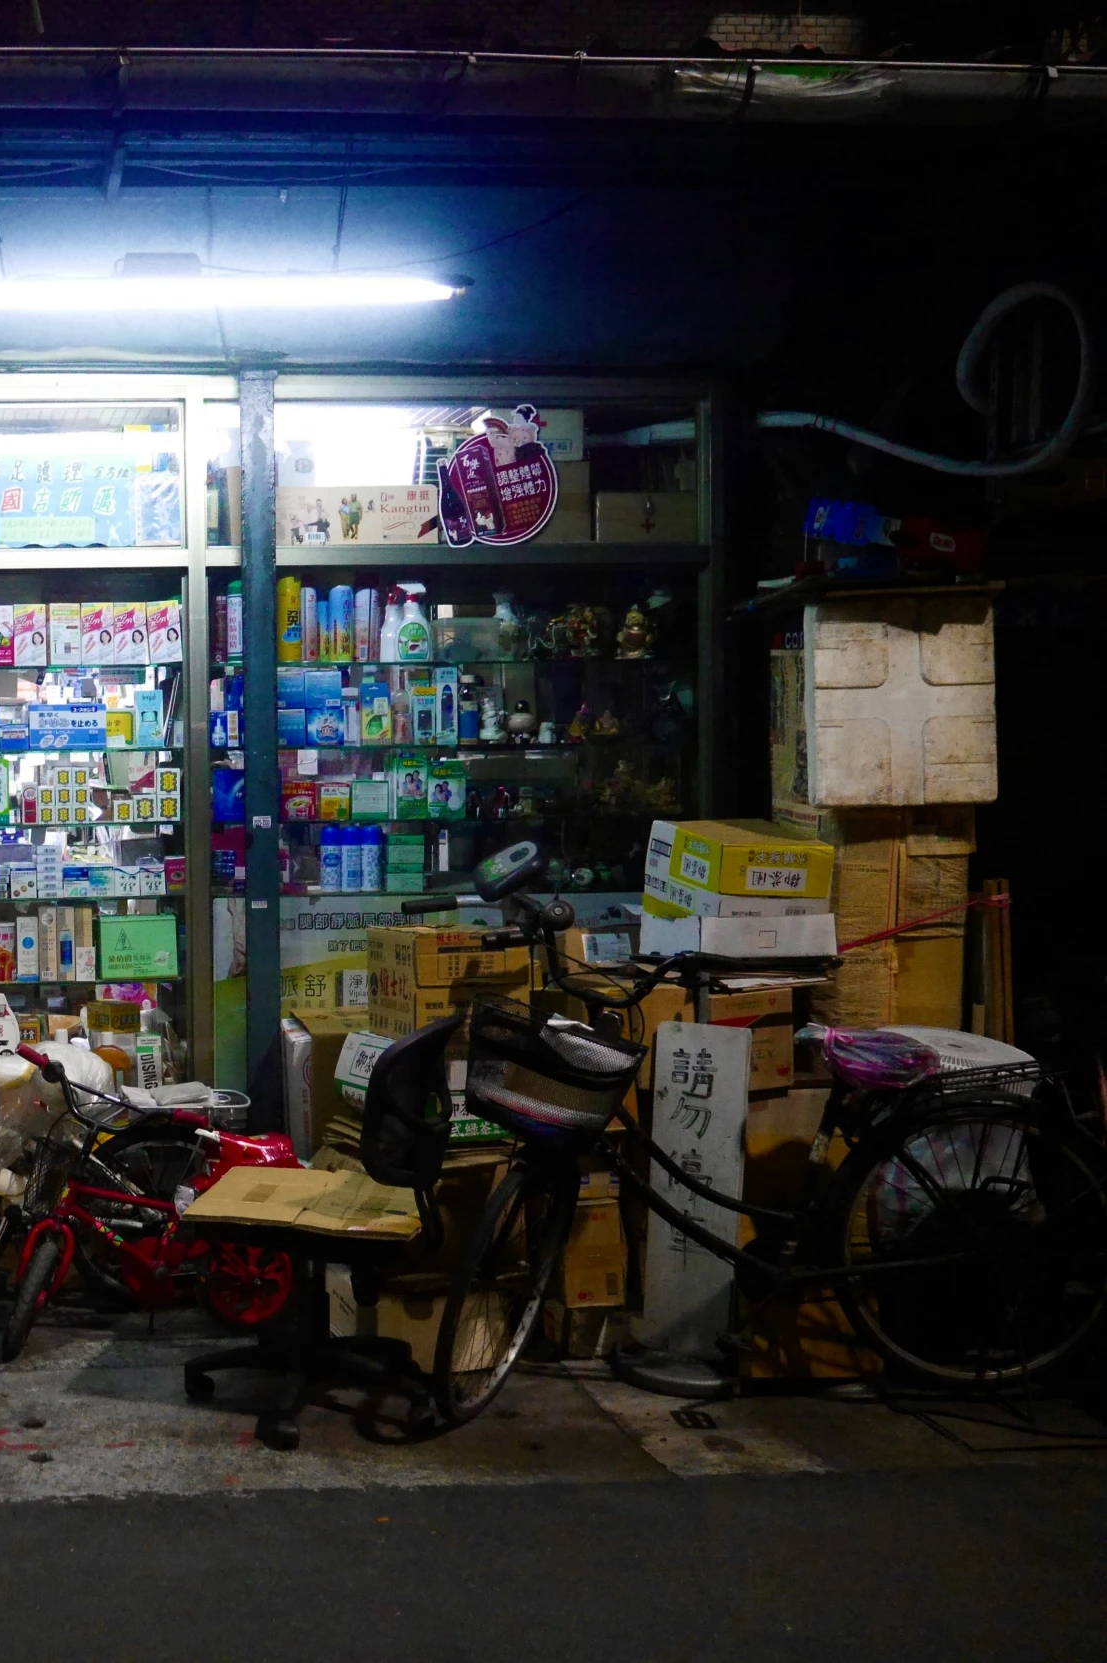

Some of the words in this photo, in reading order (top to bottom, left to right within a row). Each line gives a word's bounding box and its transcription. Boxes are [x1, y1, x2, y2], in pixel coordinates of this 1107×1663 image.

[407, 490, 430, 501] 康挺
[380, 503, 430, 515] Kangtin
[750, 870, 801, 889] 御茶園
